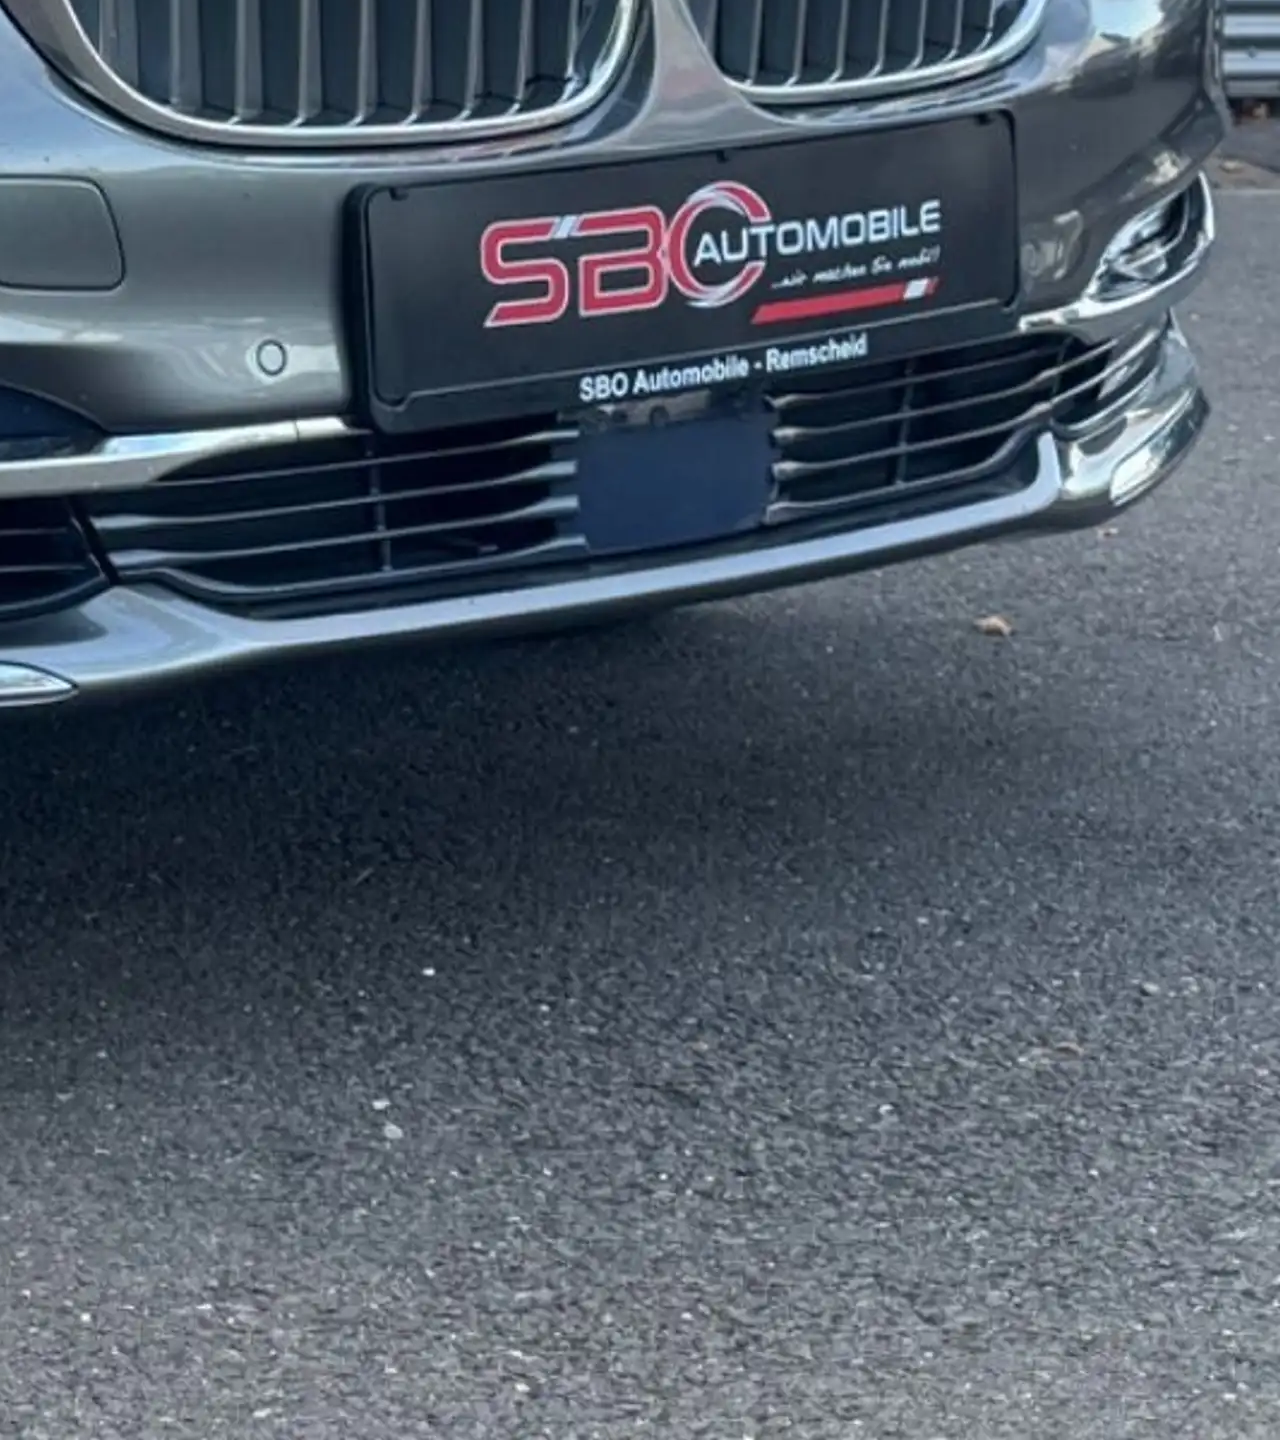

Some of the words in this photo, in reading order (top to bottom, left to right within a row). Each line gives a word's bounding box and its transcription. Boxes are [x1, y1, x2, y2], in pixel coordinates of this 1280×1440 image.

[693, 198, 942, 268] AUTOMOBILE
[579, 372, 629, 402] SBO
[632, 357, 749, 394] Automobile
[765, 334, 868, 372] Remscheid
